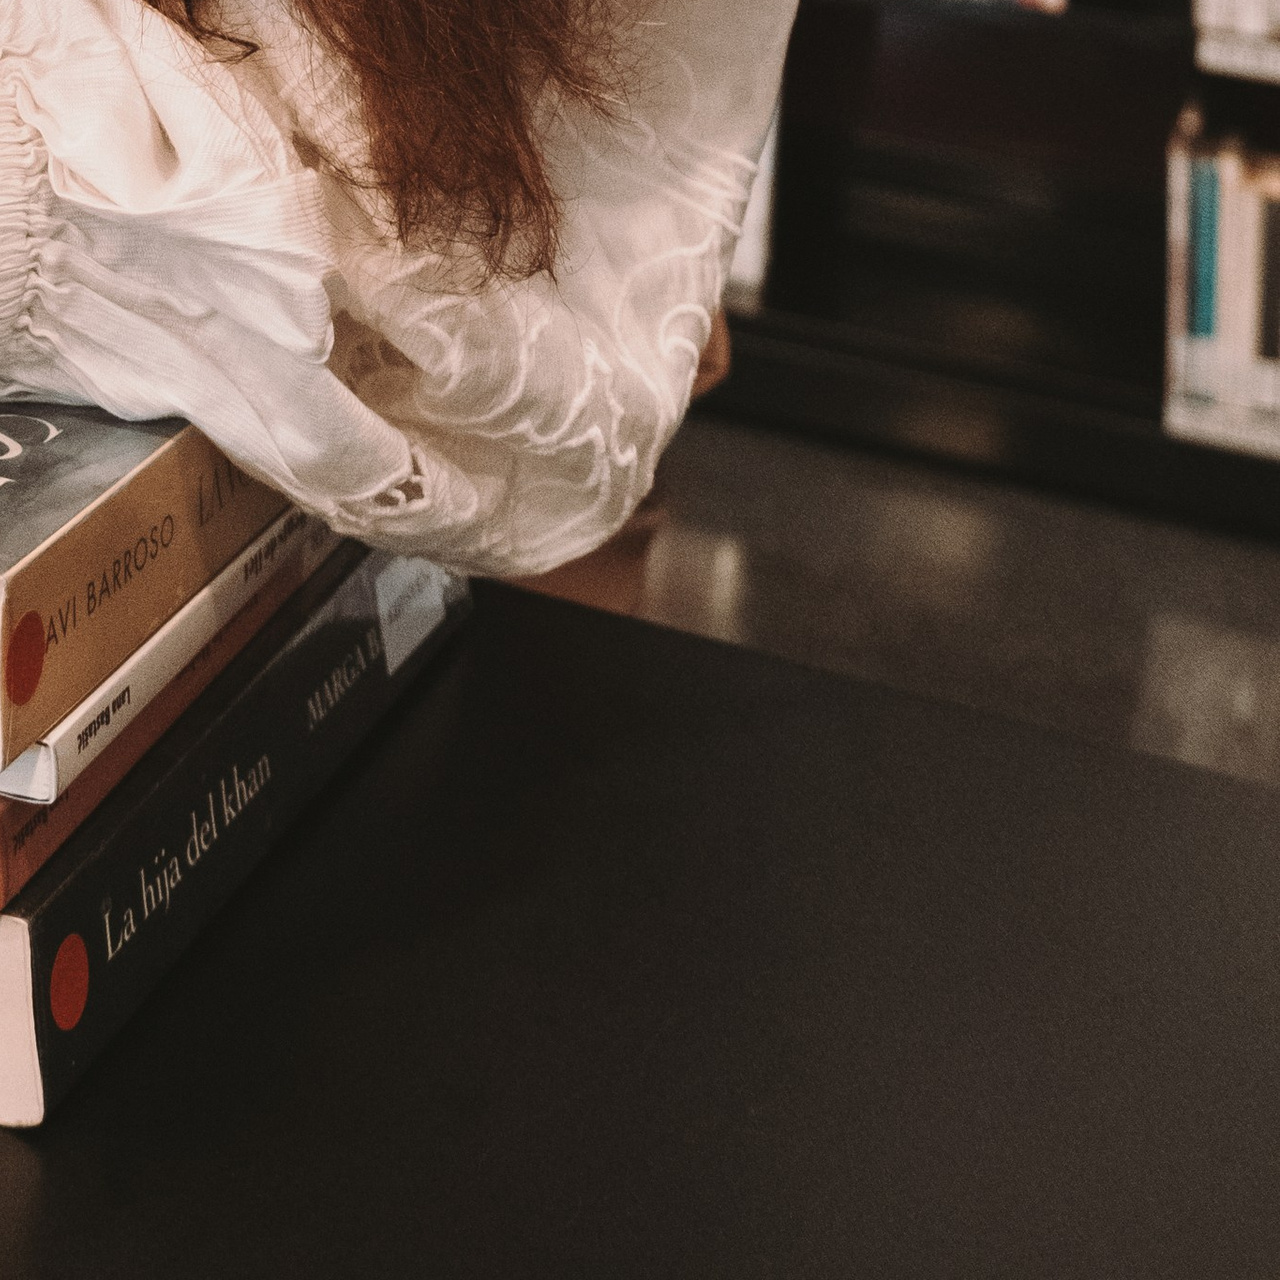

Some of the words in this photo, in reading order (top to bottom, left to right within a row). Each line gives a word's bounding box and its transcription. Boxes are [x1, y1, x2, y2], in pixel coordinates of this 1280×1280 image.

[45, 596, 77, 651] AVI
[86, 514, 175, 617] BARROSO
[112, 685, 131, 716] Lana
[307, 644, 367, 731] MARGA
[104, 907, 136, 962] La
[140, 848, 182, 920] hija
[186, 791, 218, 867] del
[220, 753, 271, 827] khan
